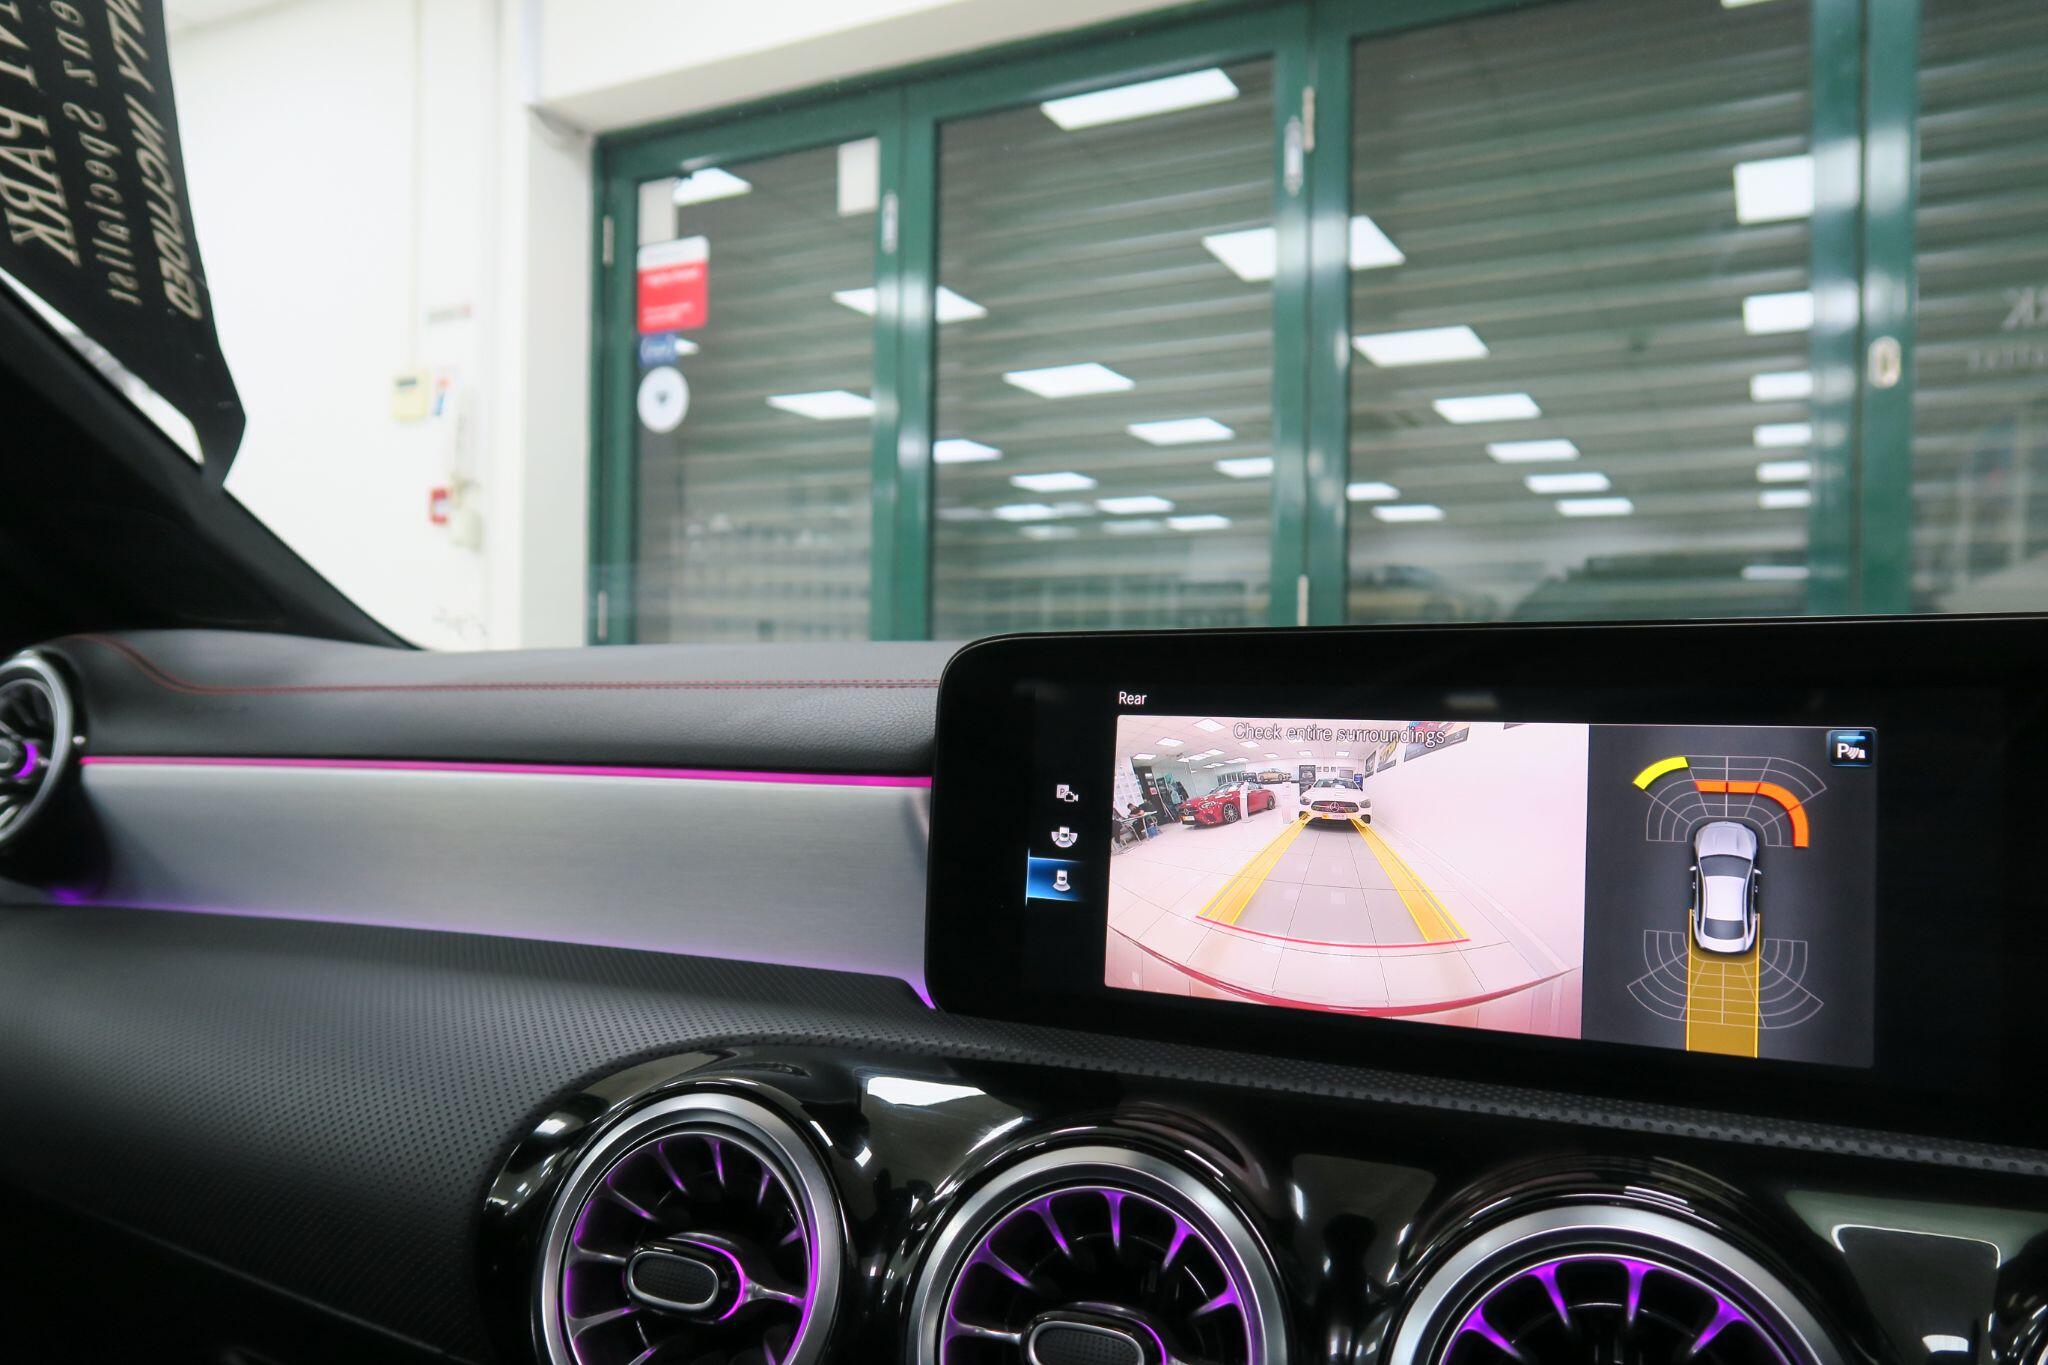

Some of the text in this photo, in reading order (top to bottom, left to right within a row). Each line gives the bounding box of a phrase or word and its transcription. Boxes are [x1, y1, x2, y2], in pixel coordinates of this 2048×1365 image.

[1118, 691, 1147, 705] Rear
[1234, 722, 1446, 748] Check entire surroundings
